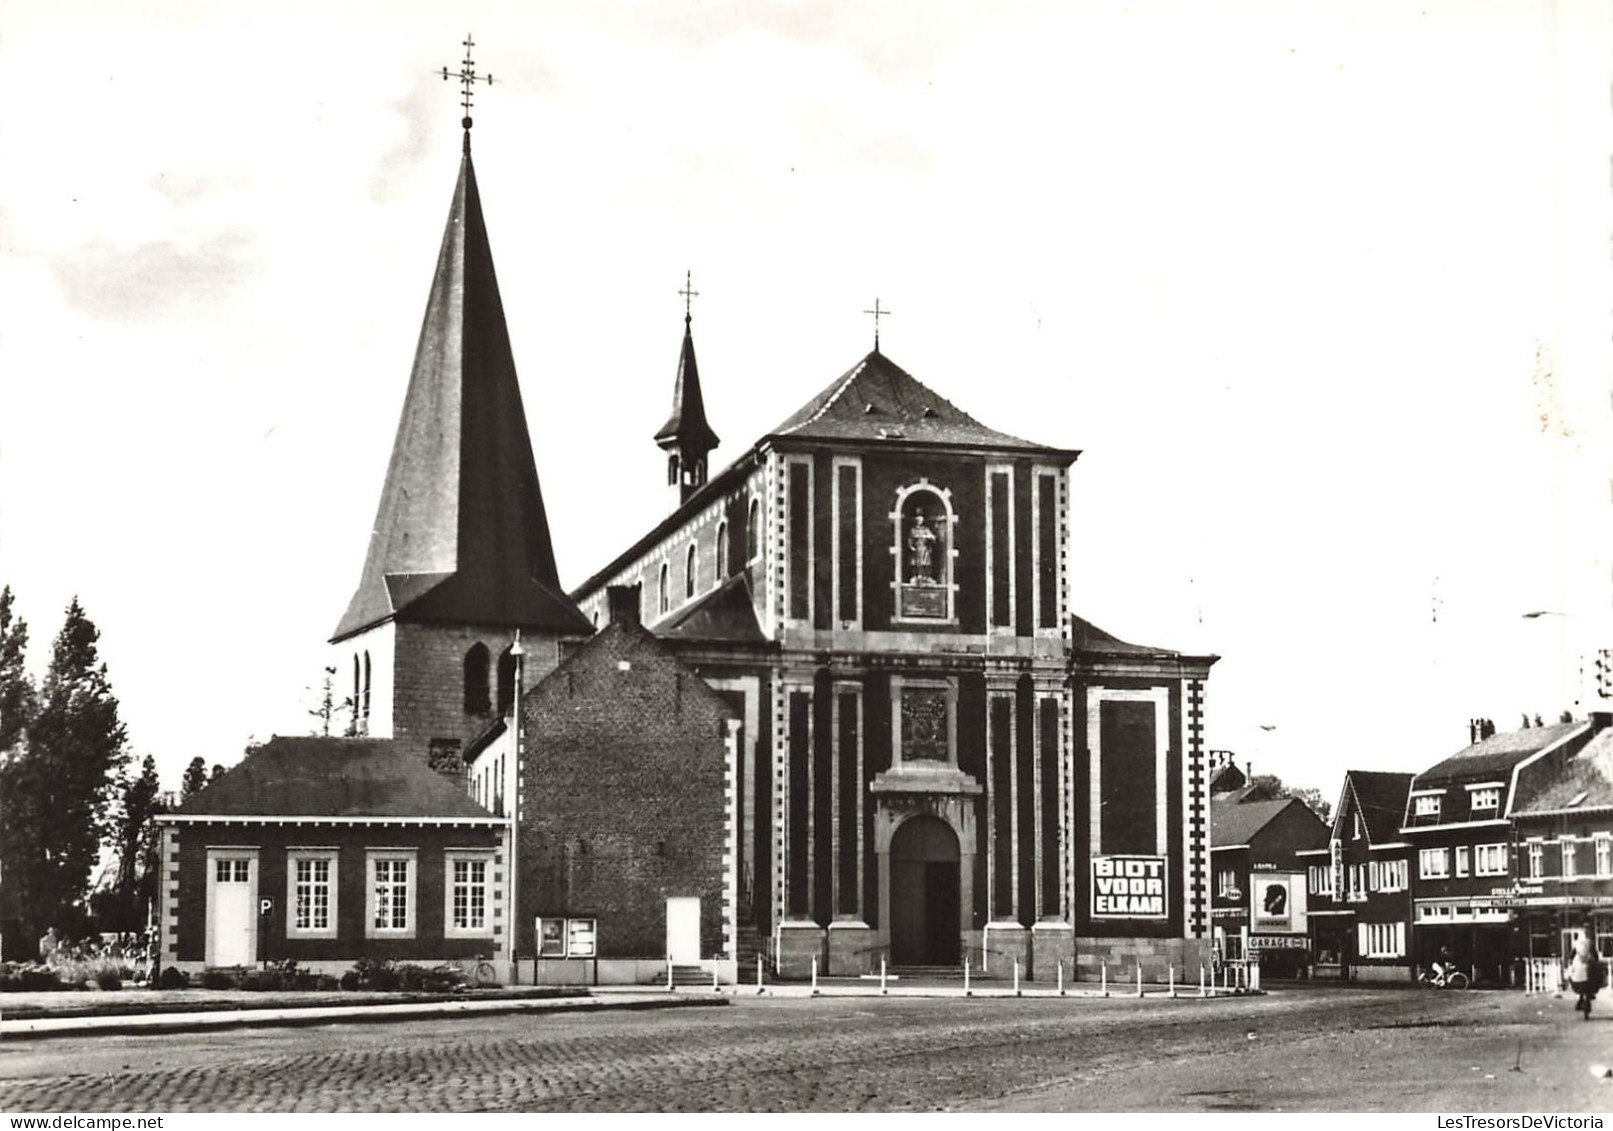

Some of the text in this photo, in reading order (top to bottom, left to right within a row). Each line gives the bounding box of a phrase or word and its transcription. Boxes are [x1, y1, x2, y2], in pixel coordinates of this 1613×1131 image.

[1096, 878, 1162, 895] VOOR
[260, 899, 272, 915] P
[1096, 895, 1163, 913] ELKAAR
[1251, 938, 1288, 947] GARAGE
